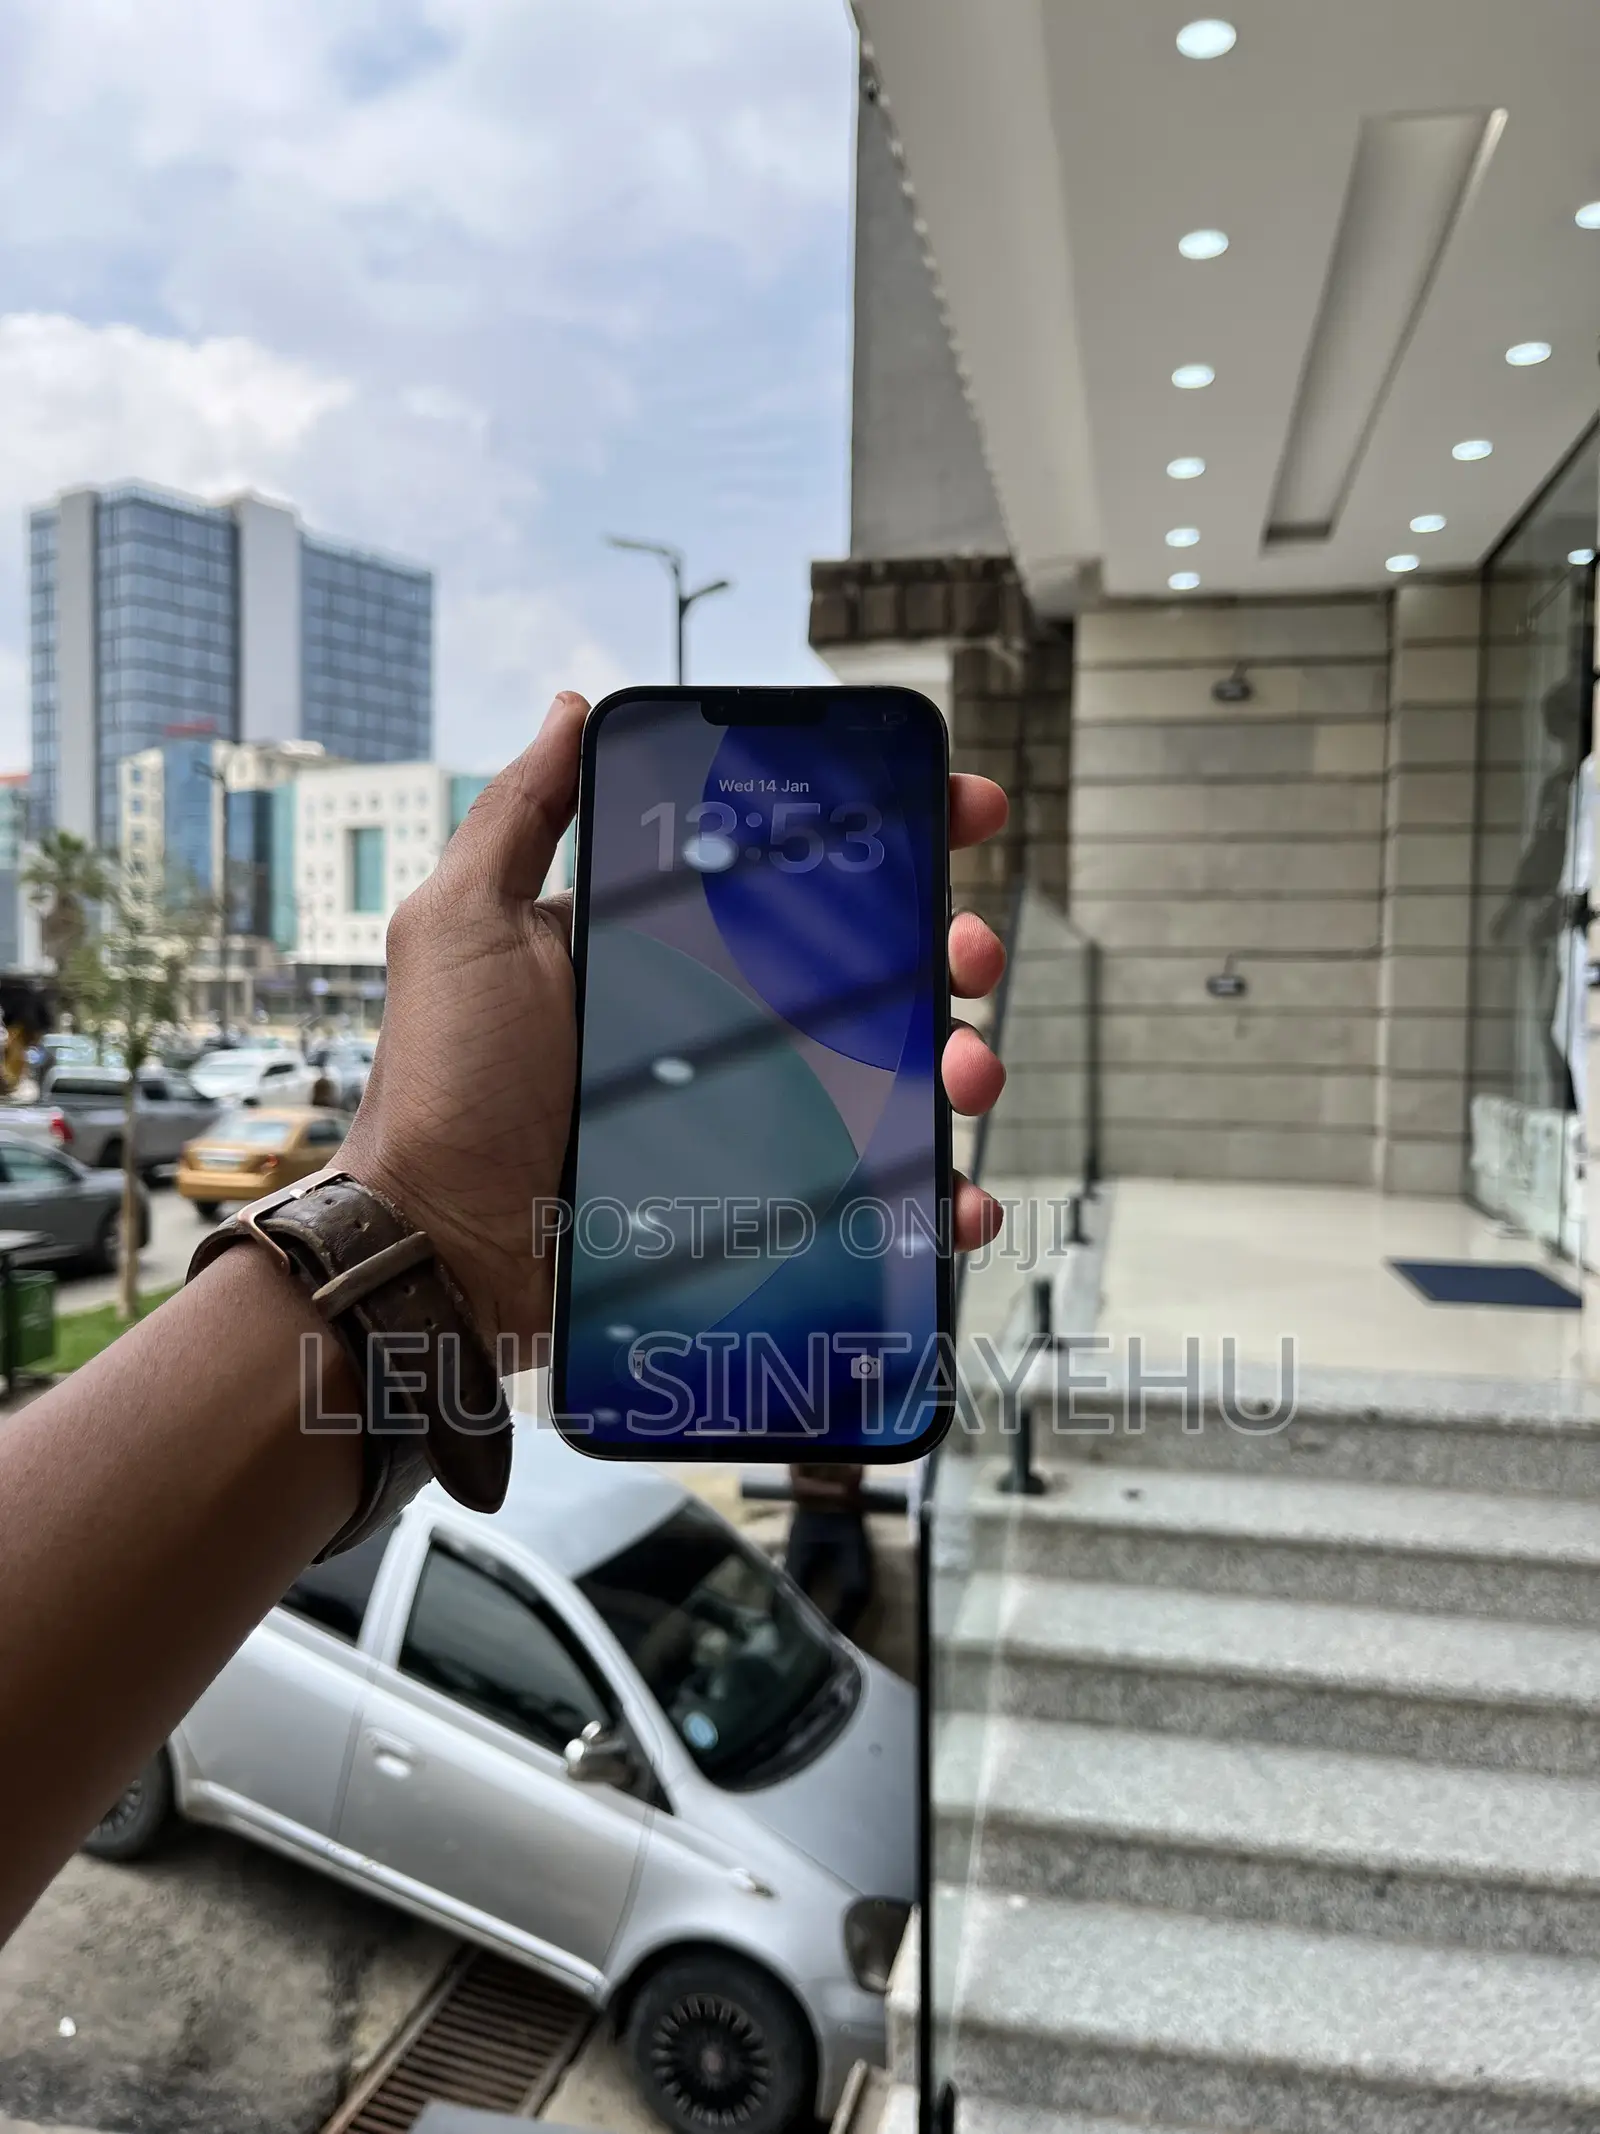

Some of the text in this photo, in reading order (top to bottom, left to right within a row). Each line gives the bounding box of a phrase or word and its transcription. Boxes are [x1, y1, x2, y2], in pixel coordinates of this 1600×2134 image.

[719, 779, 810, 793] Wed 14 Jan
[640, 801, 885, 873] 13:53
